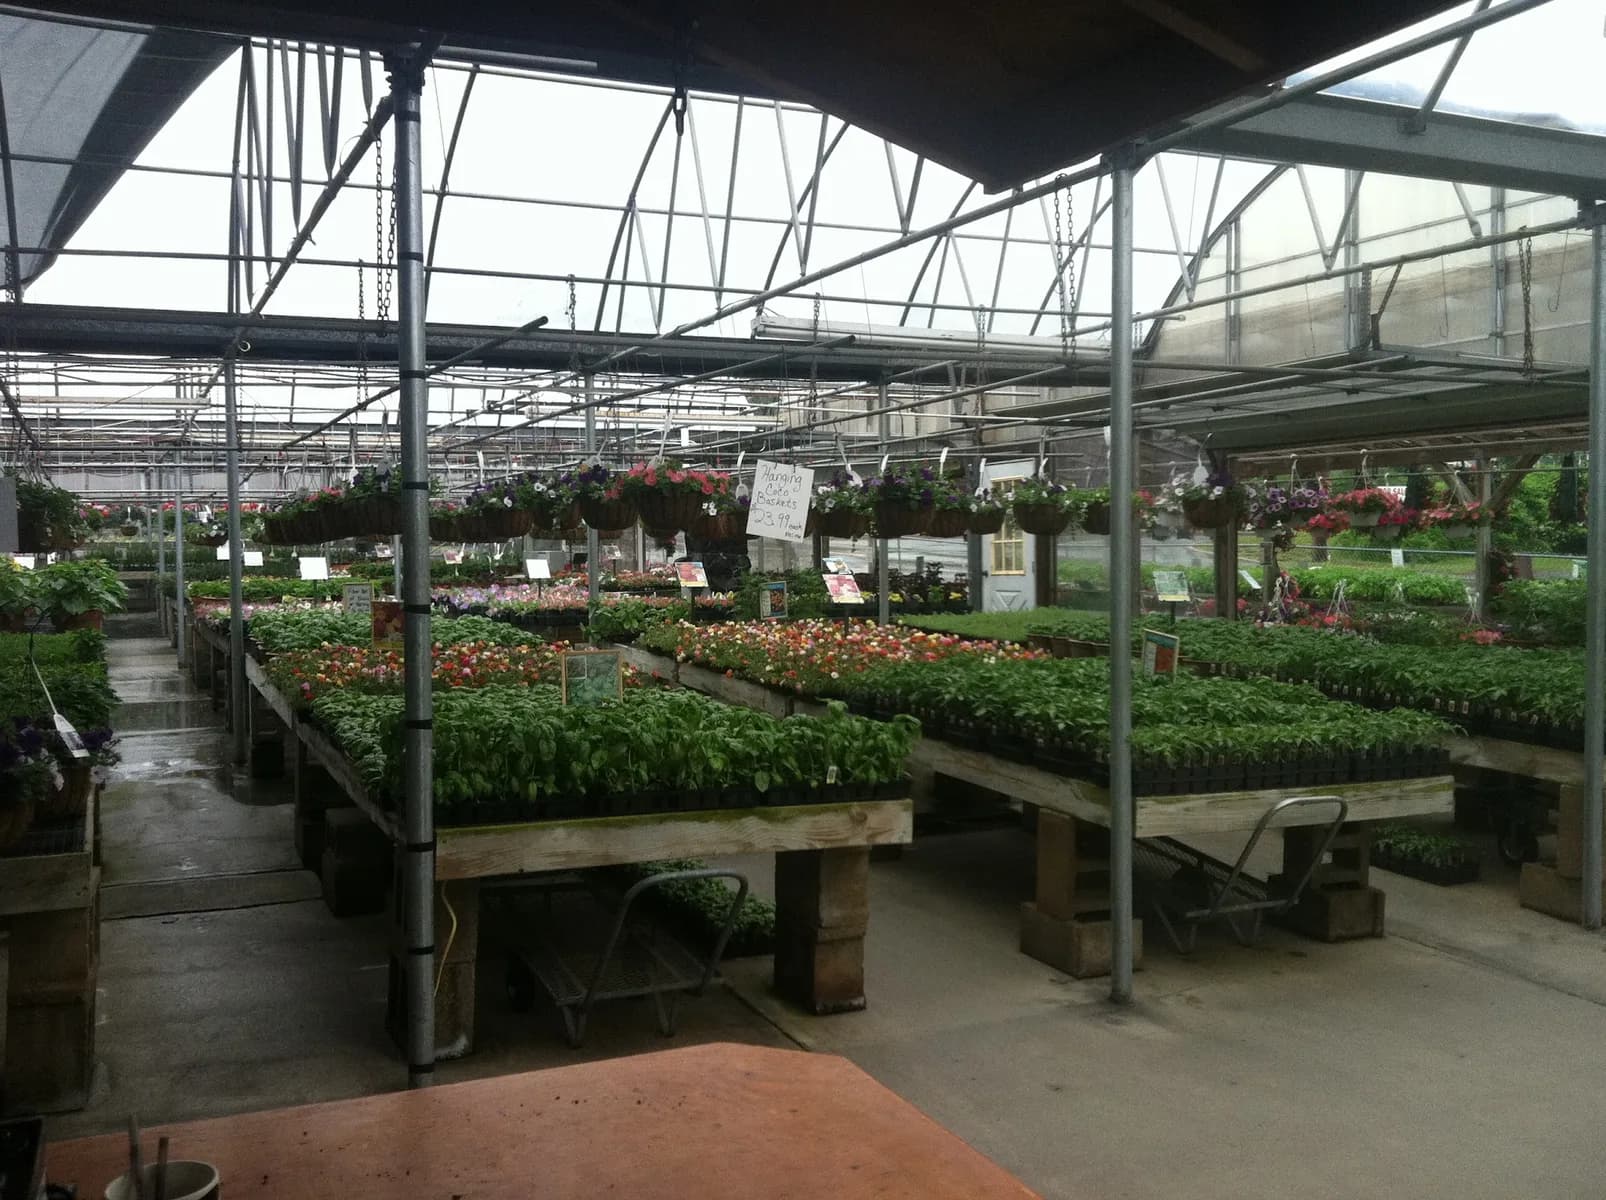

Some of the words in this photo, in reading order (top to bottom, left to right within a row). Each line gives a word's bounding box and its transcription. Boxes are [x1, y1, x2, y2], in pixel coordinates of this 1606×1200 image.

[761, 464, 802, 492] Hanging
[765, 483, 789, 497] Coco
[757, 491, 797, 510] Baskets
